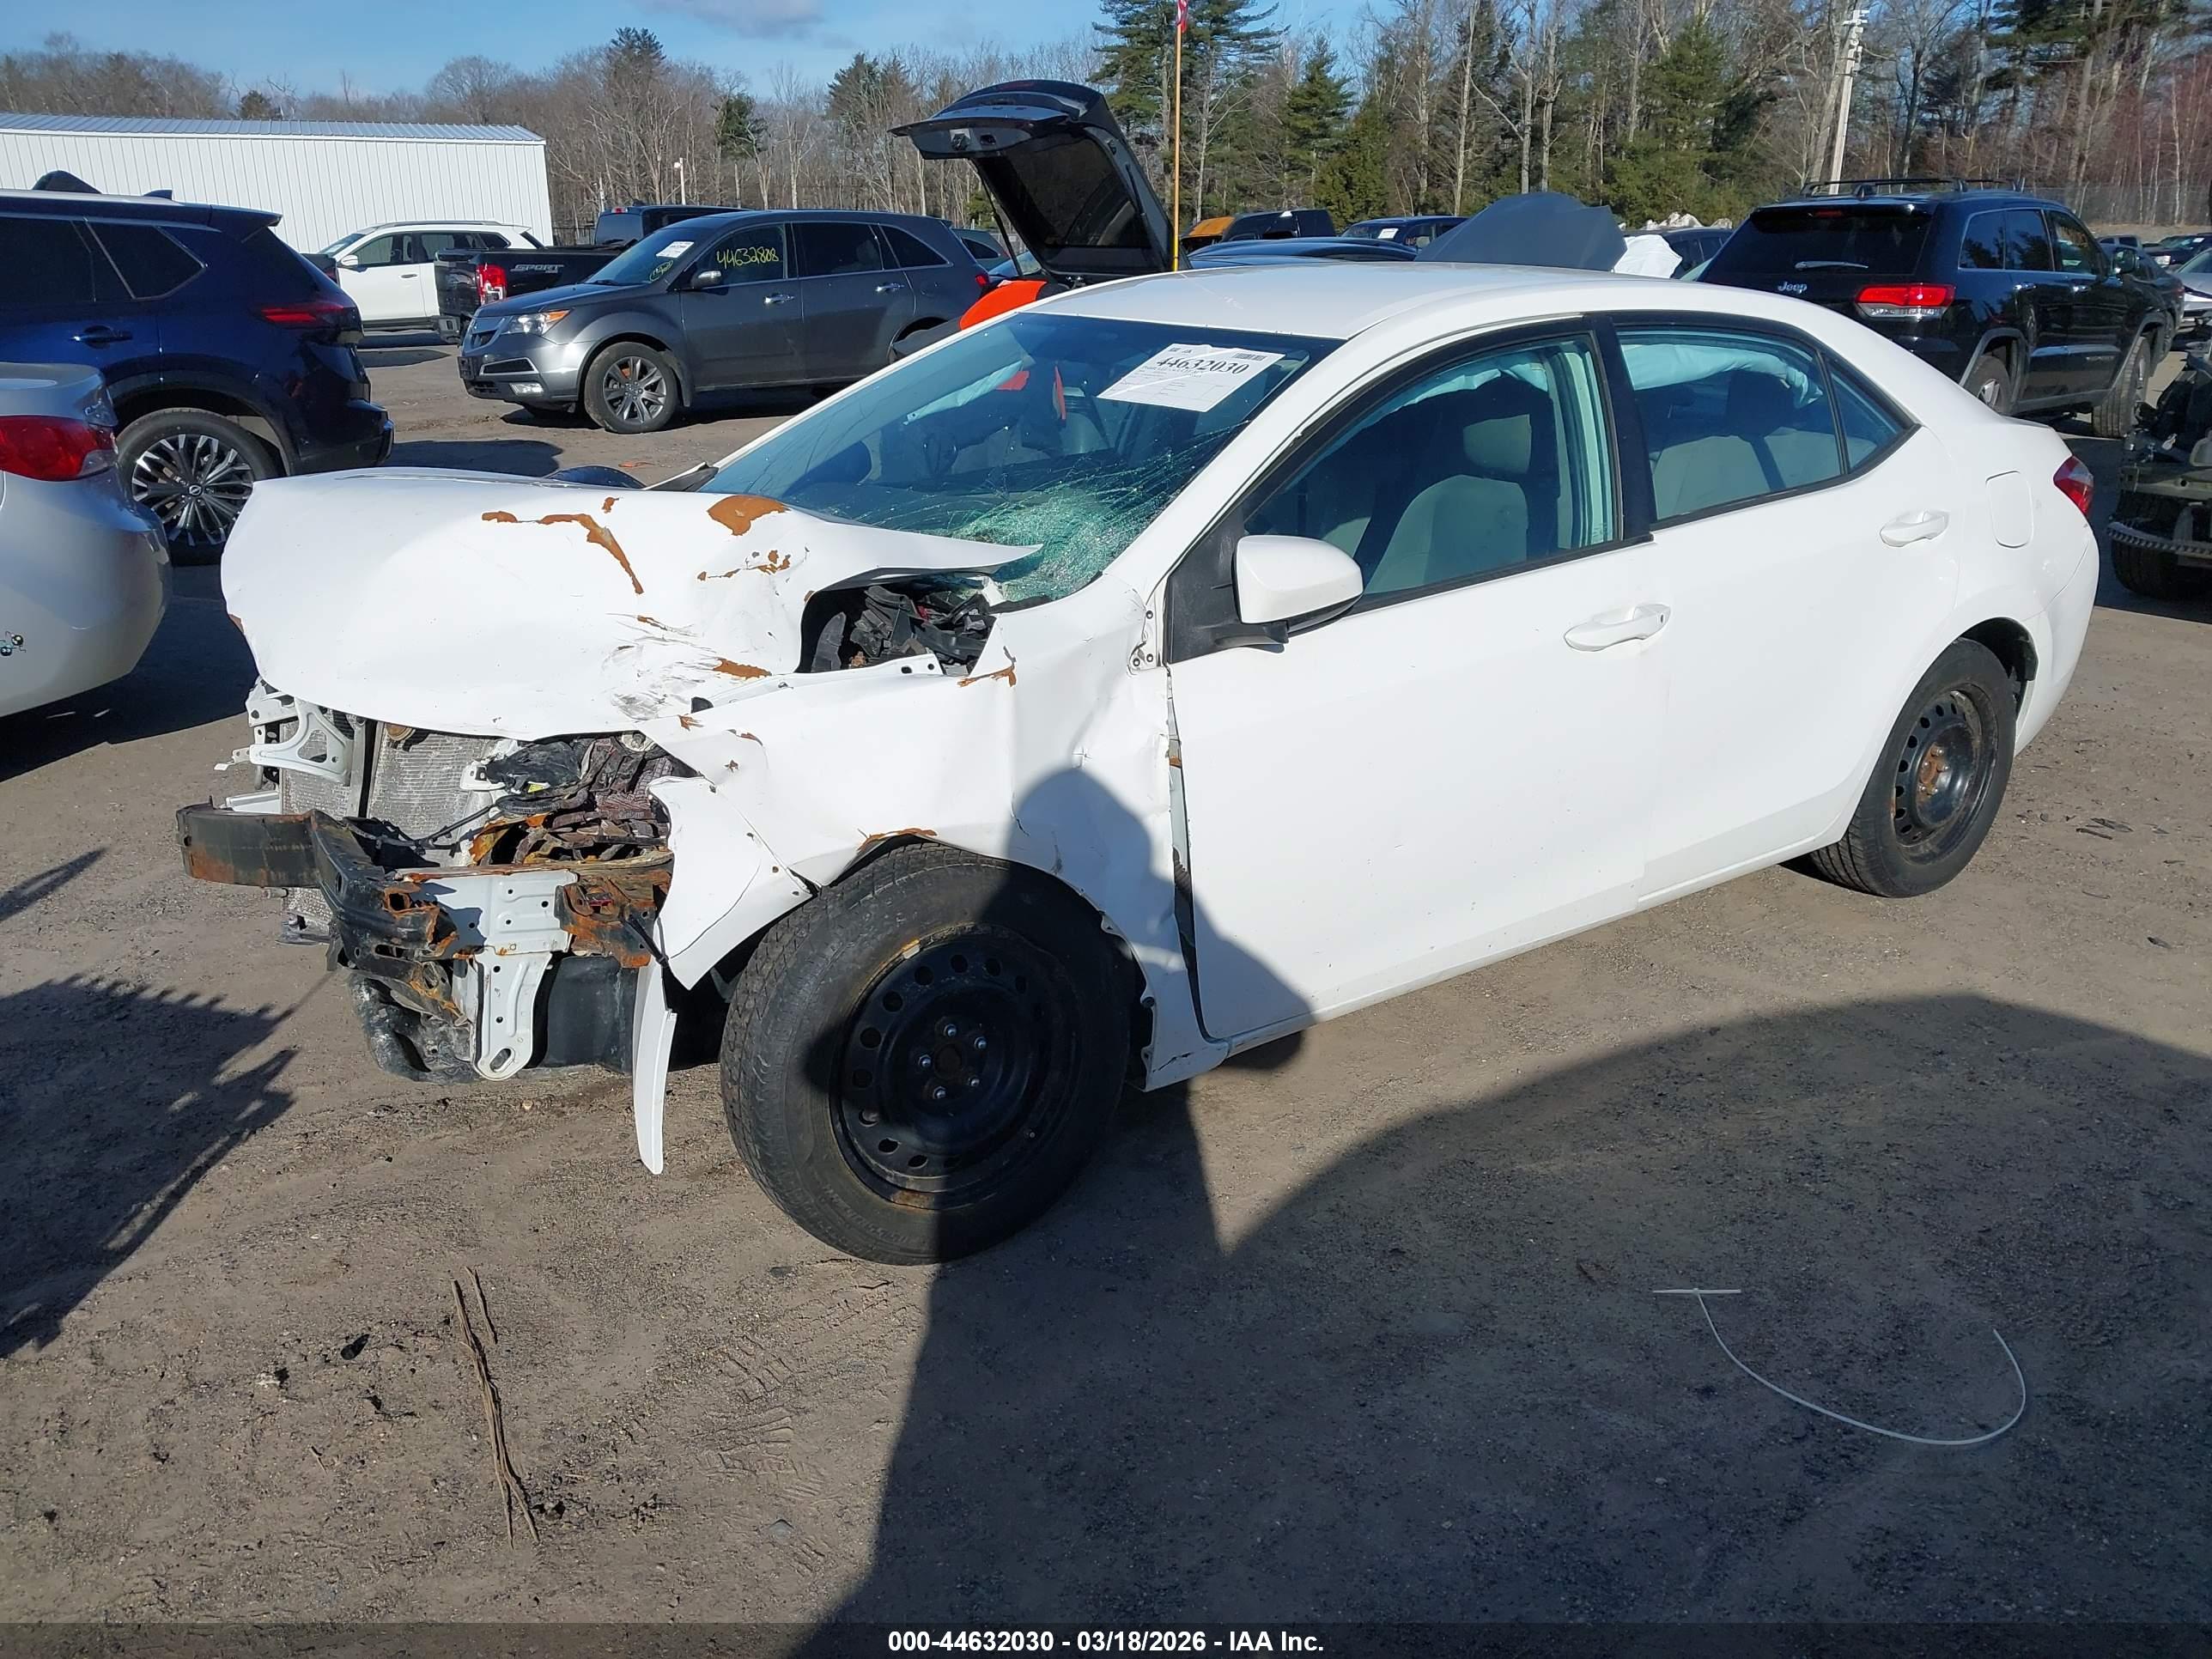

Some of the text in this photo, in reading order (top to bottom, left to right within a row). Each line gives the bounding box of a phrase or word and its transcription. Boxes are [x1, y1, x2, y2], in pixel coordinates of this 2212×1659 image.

[510, 264, 564, 272] SPORT
[1778, 281, 1808, 294] Jeep
[1156, 356, 1250, 374] 44632030
